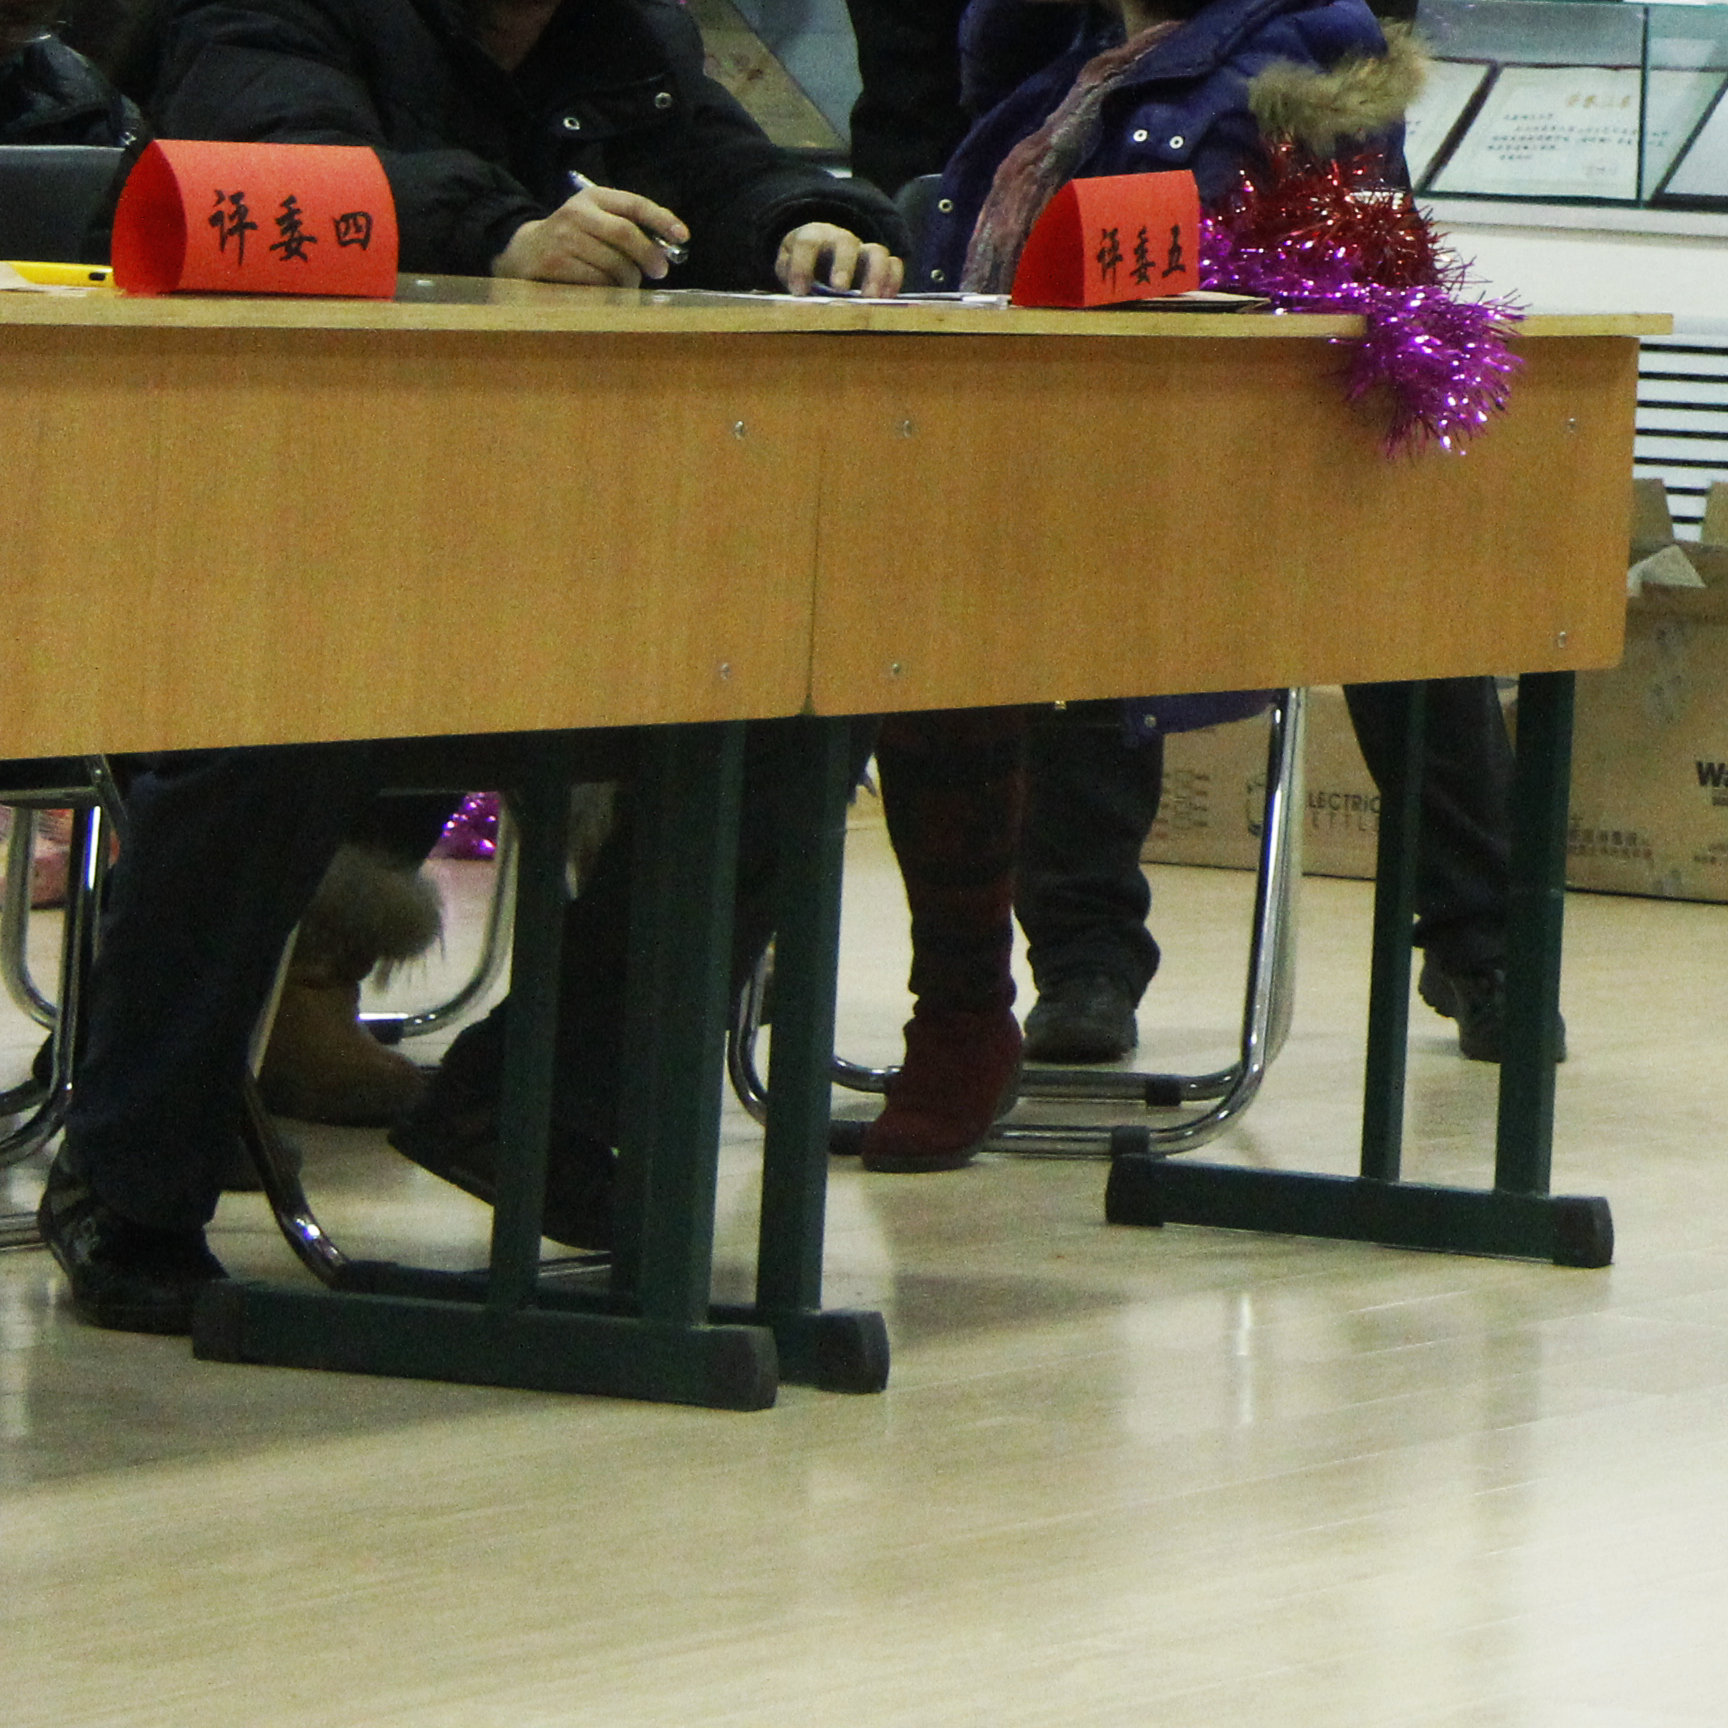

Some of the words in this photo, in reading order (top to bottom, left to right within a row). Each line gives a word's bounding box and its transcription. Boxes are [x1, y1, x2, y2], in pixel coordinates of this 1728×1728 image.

[208, 189, 374, 267] 评委四
[1096, 224, 1187, 295] 评委五
[1309, 791, 1381, 814] LECTRIC
